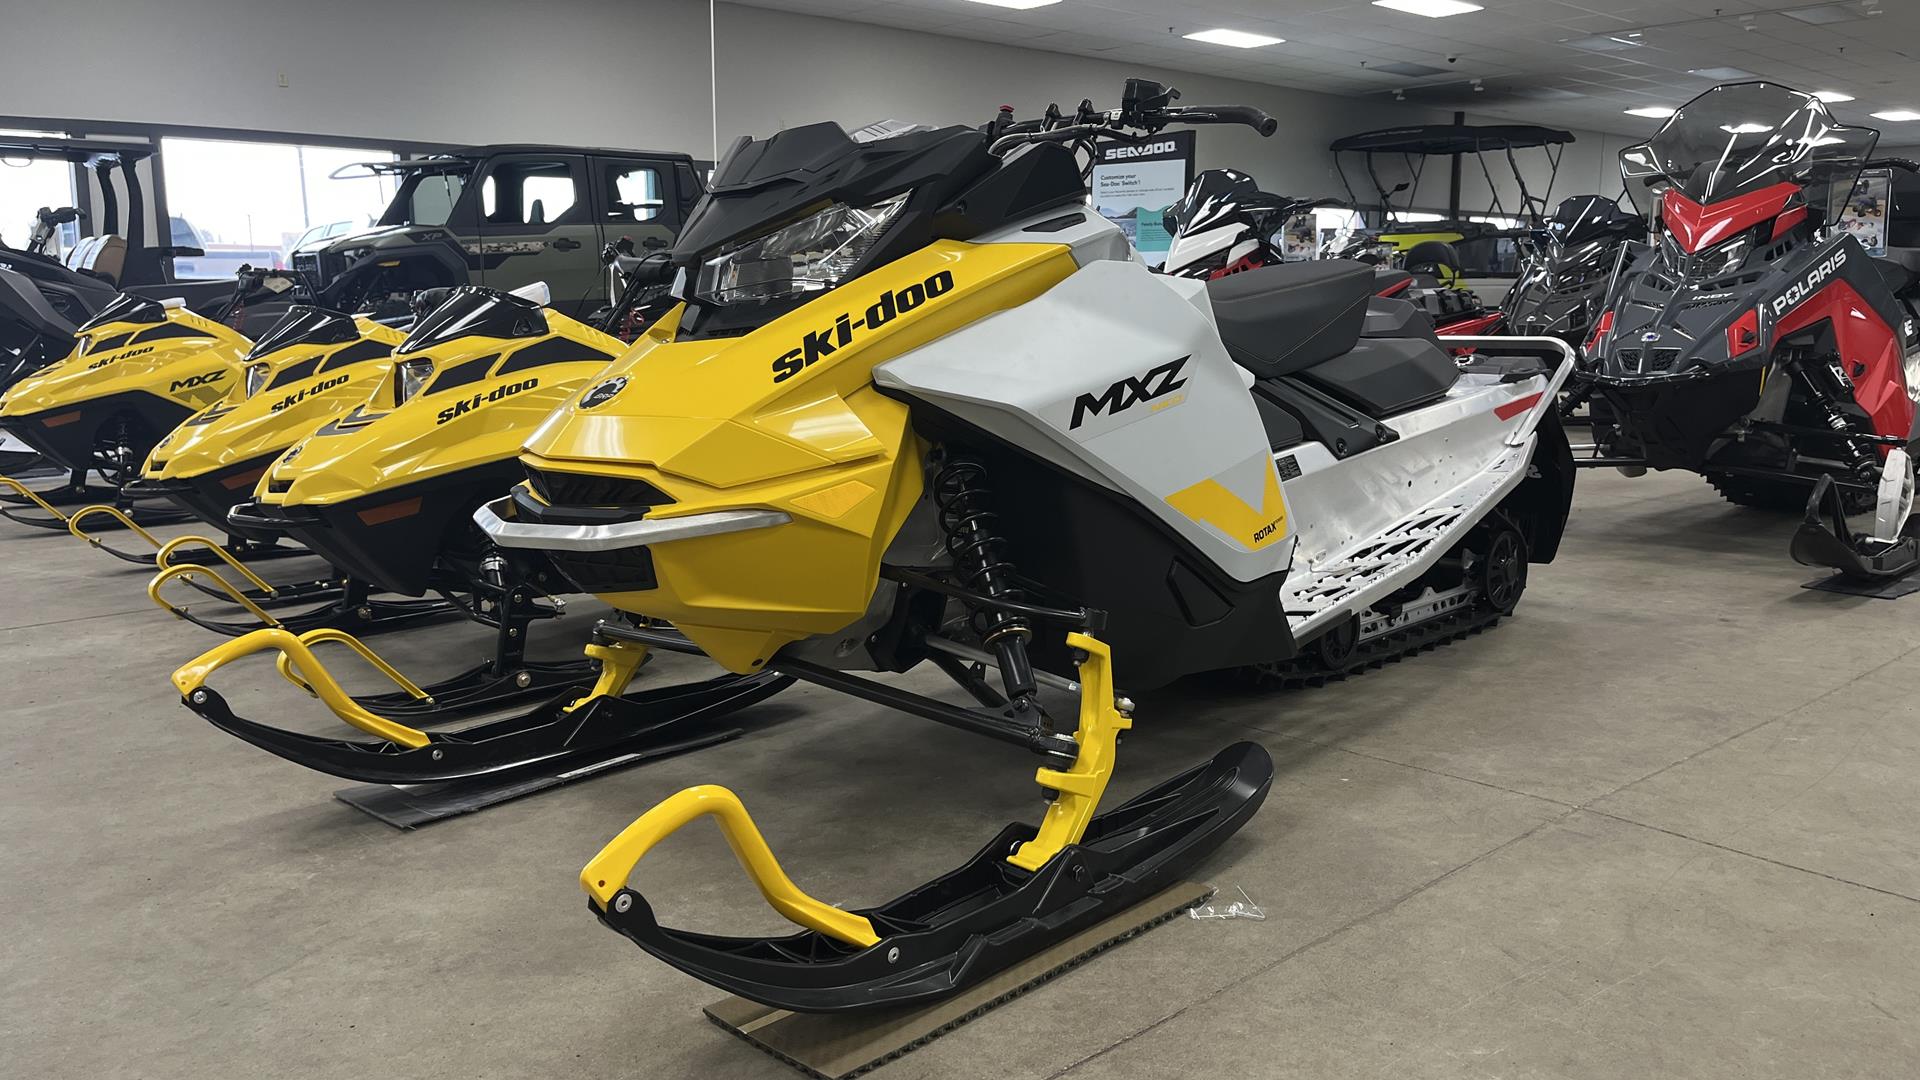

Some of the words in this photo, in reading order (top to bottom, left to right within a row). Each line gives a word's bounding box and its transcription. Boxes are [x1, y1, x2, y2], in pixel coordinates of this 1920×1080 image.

[1125, 174, 1137, 182] your
[421, 232, 442, 241] XP
[1772, 248, 1847, 316] POLARIS
[1692, 292, 1734, 301] INDY
[772, 270, 954, 384] ski-doo
[88, 346, 154, 370] ski-doo
[169, 368, 229, 392] MXZ
[1069, 353, 1192, 431] MXZ
[271, 374, 350, 414] ski-doo
[436, 377, 539, 425] ski-doo
[1253, 521, 1277, 543] ROTAX
